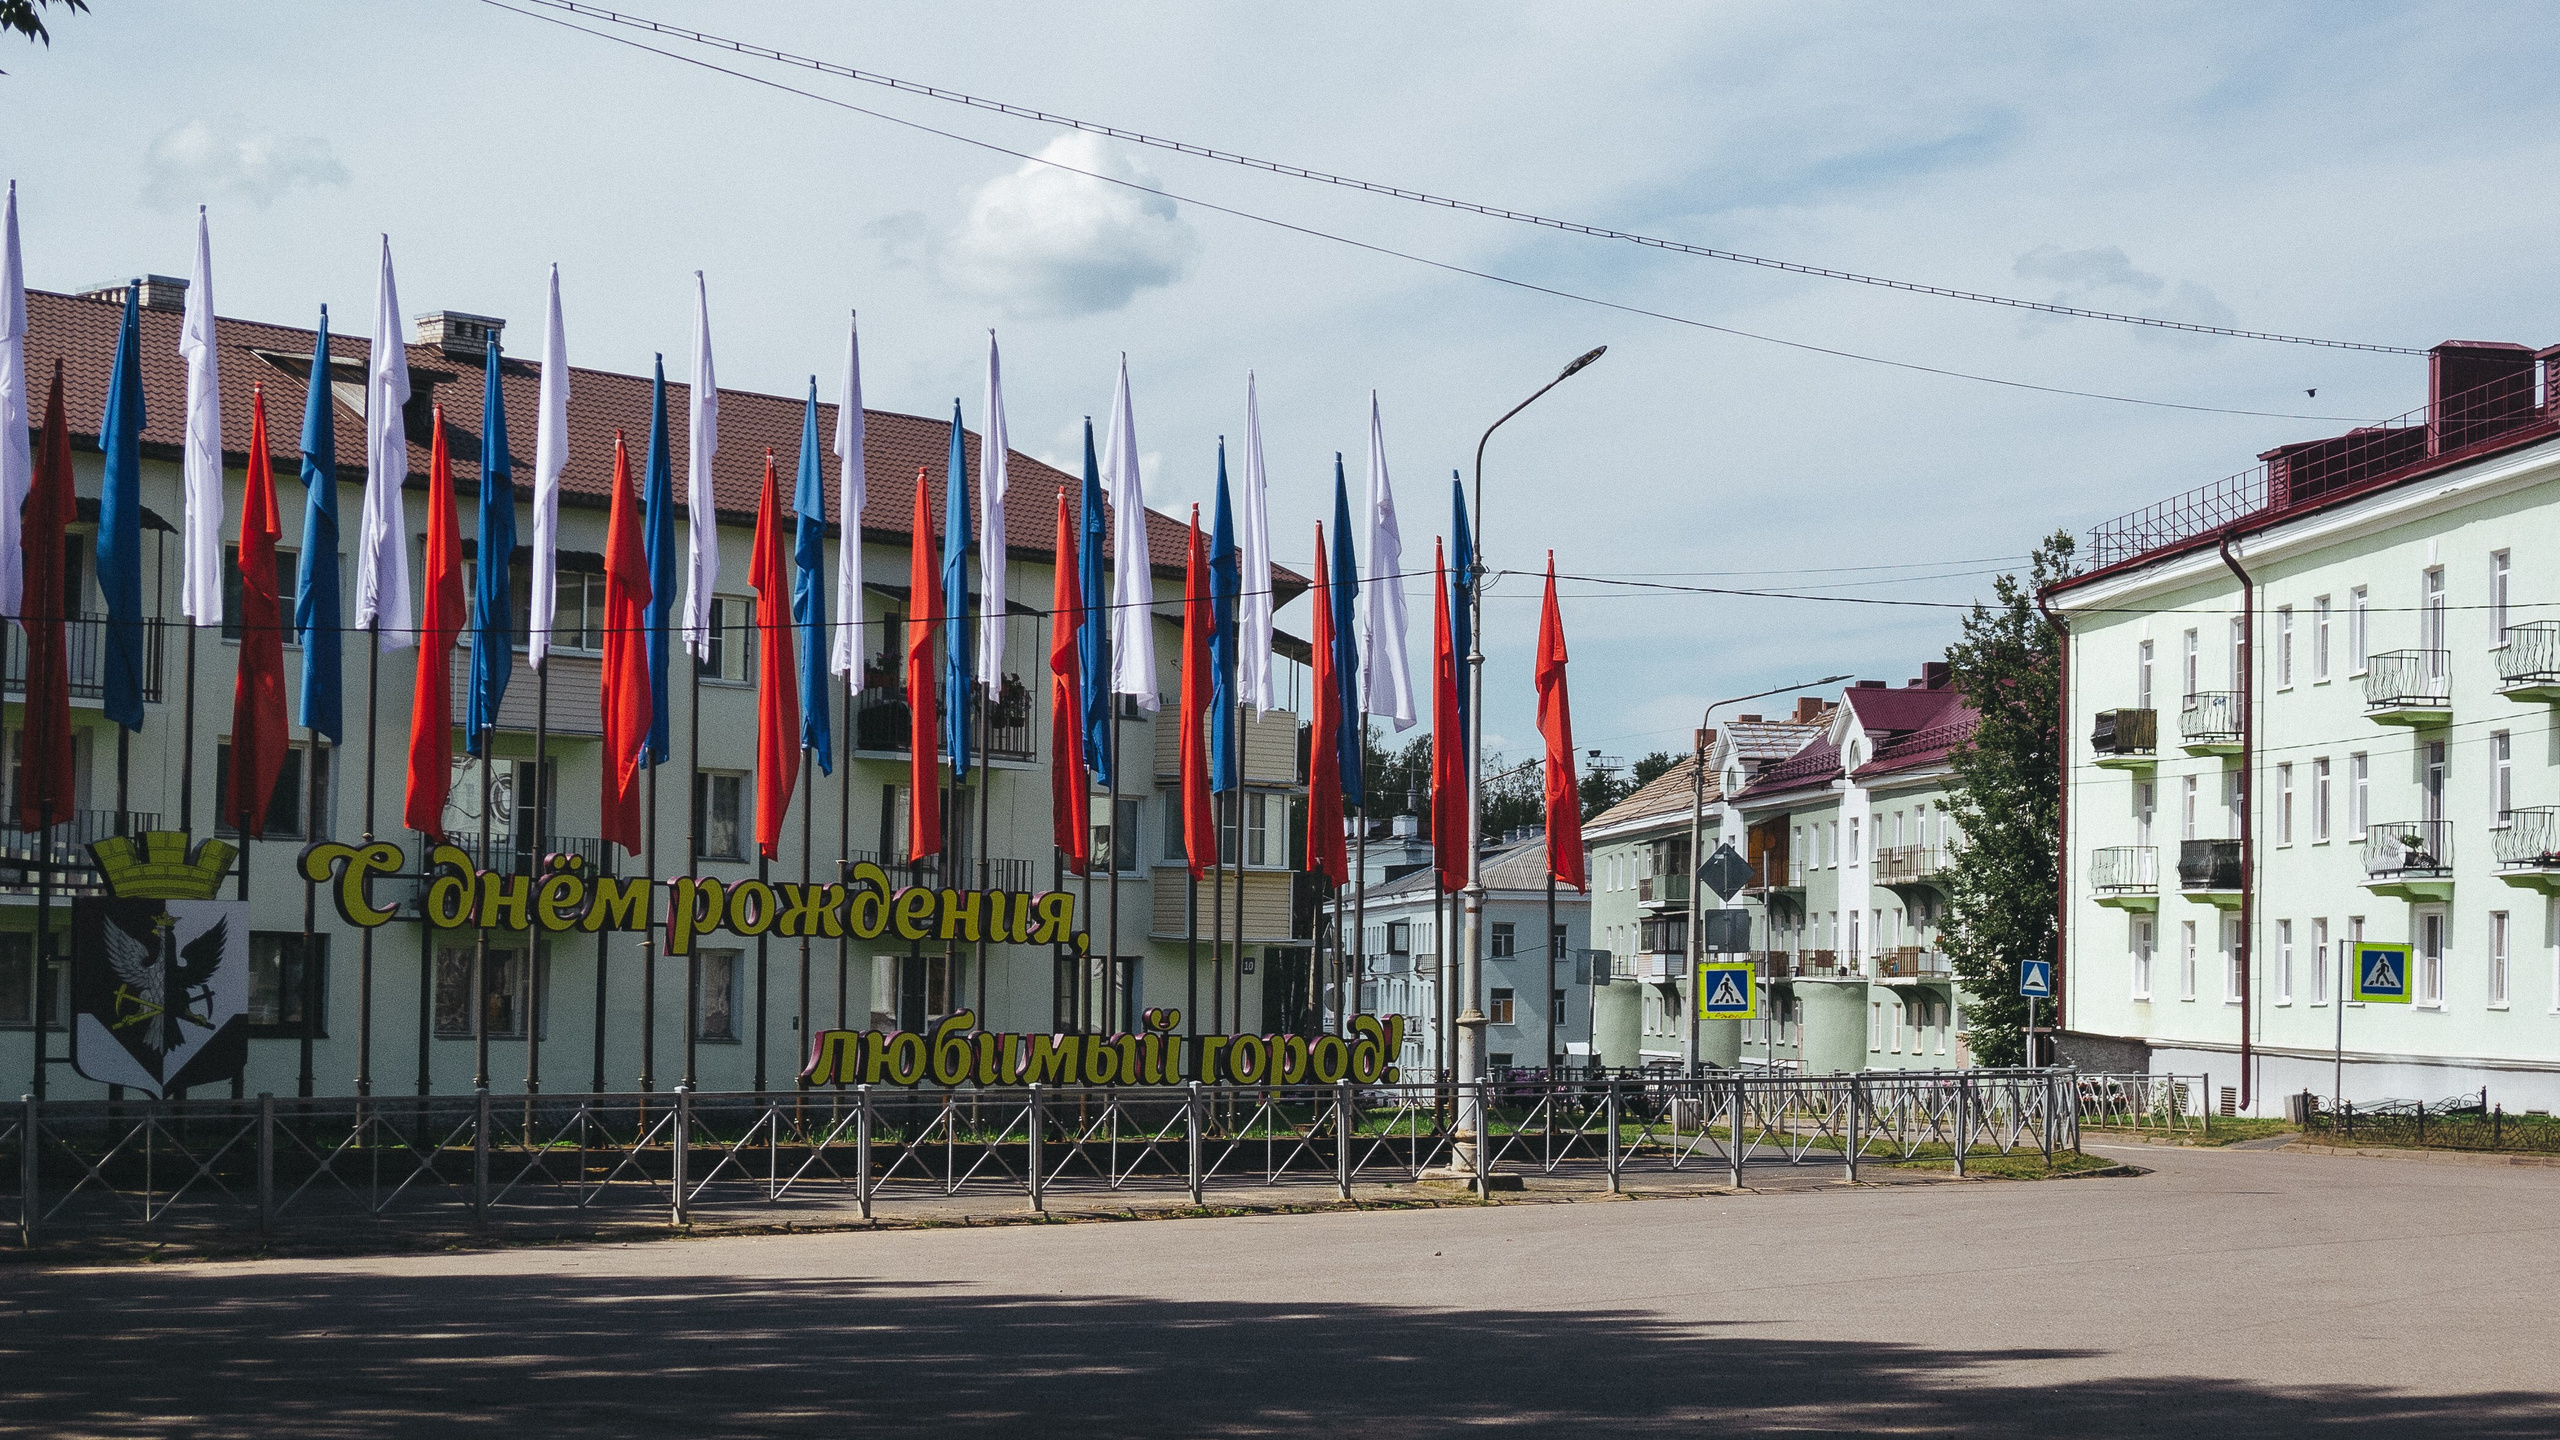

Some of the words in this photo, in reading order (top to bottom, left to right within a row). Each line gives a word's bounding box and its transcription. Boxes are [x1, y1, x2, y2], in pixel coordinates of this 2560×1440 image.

[298, 838, 405, 929] С
[419, 844, 651, 932] днём
[663, 861, 1090, 956] рождения,
[1244, 961, 1254, 971] 10
[801, 1007, 1183, 1085] любимый
[1199, 1013, 1404, 1104] город!
